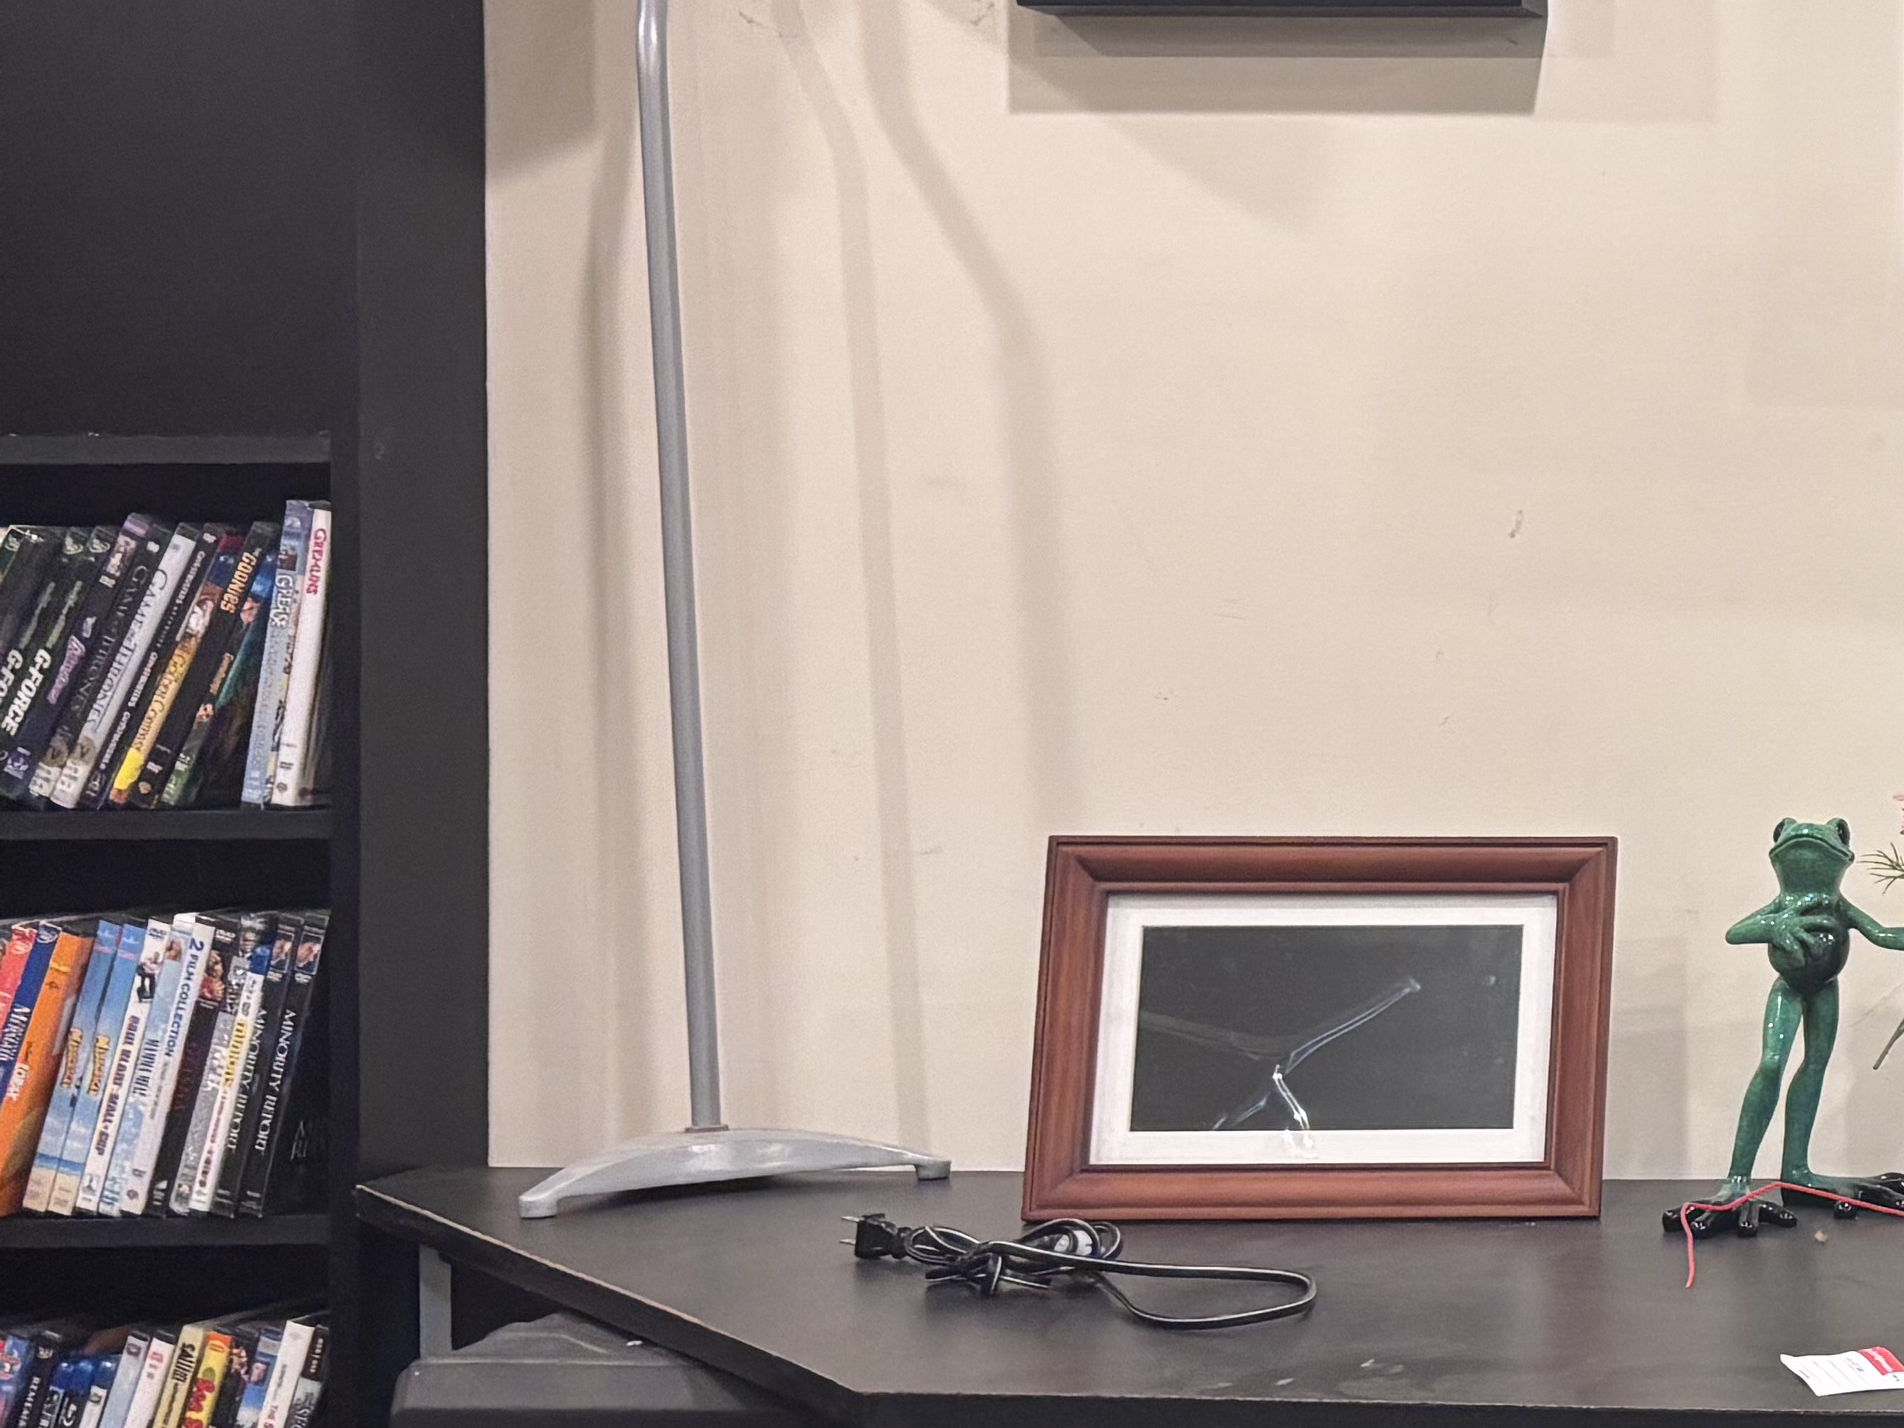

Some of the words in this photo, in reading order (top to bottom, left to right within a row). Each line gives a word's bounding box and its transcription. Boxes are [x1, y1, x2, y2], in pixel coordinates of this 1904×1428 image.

[0, 646, 54, 737] G-FORCE
[184, 953, 199, 981] FILM
[189, 938, 204, 953] 2
[164, 981, 192, 1058] COLLECTION
[238, 1006, 269, 1089] MINORITY
[268, 1007, 296, 1091] MINORITY
[225, 1092, 249, 1153] REPORT
[253, 1093, 278, 1156] REPORT
